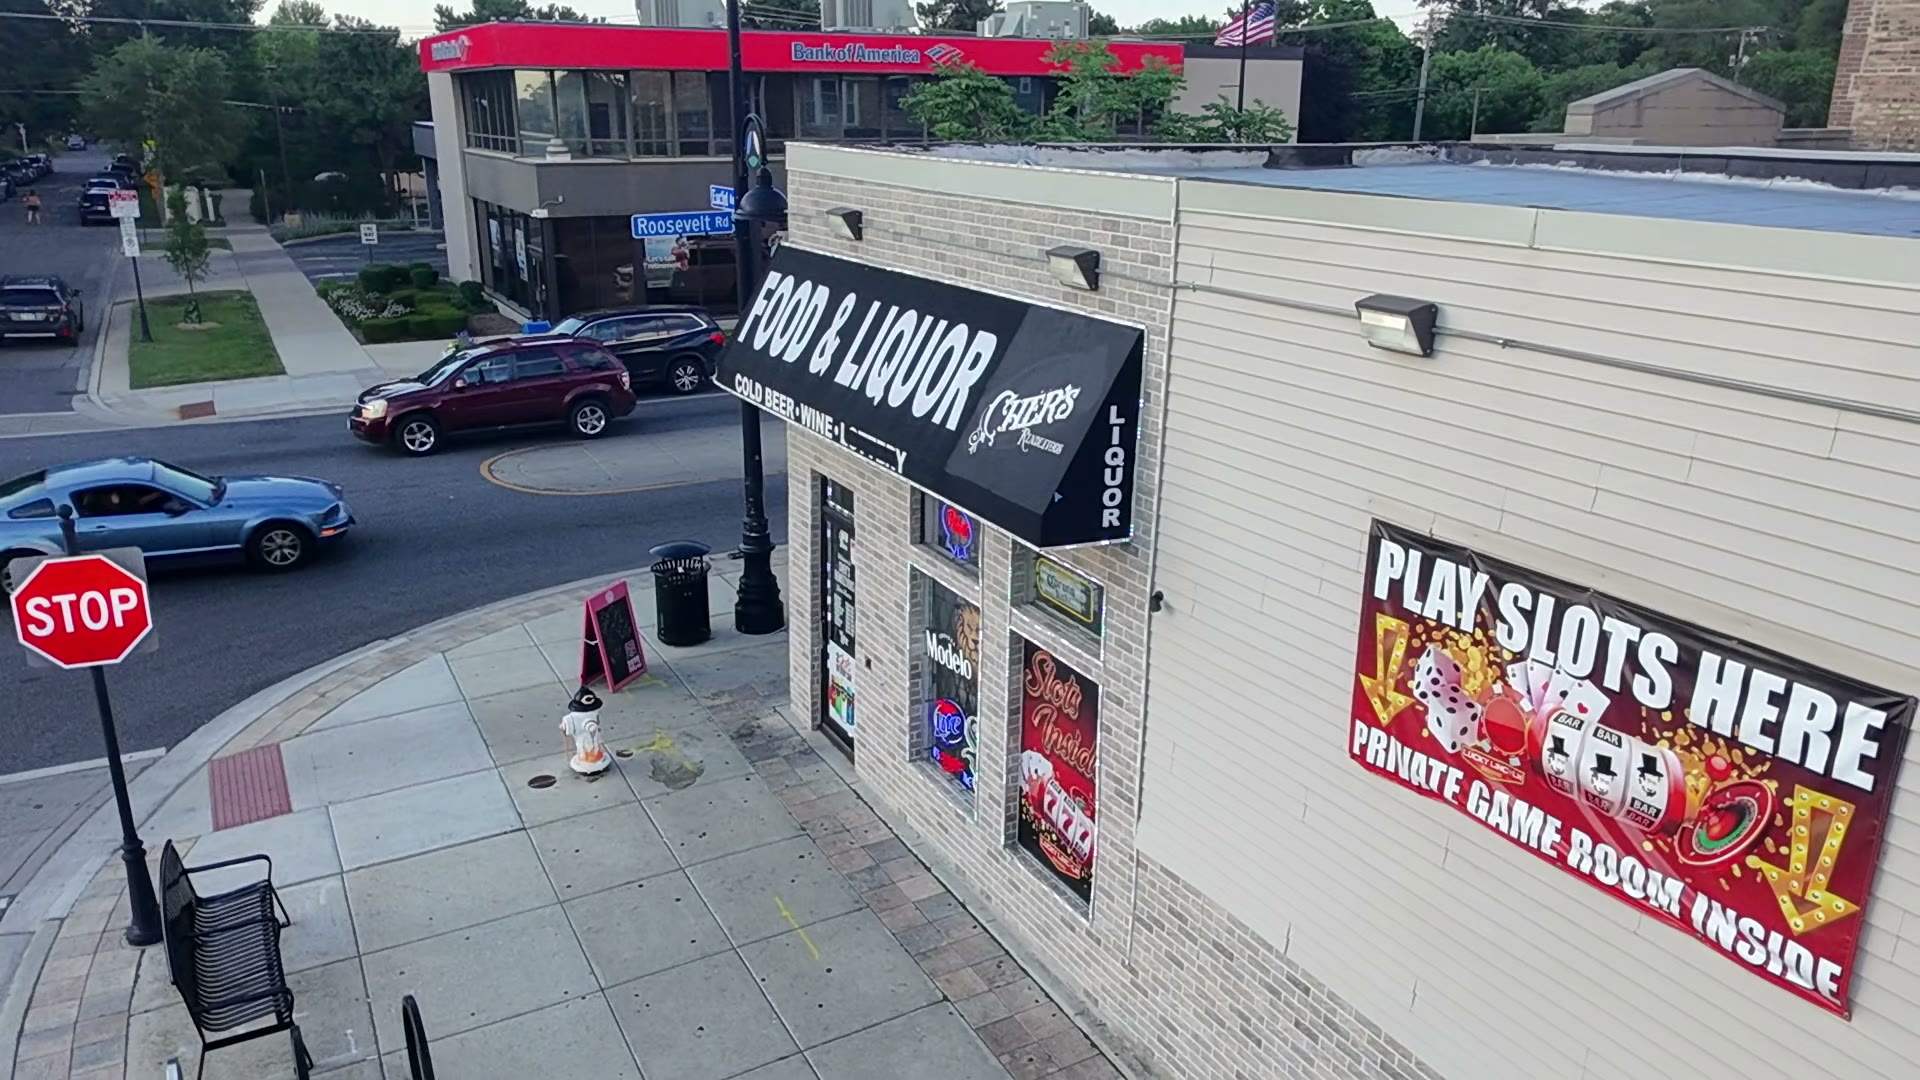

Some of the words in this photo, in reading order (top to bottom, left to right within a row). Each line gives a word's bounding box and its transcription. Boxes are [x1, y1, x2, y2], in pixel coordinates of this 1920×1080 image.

[791, 41, 836, 62] Bank
[835, 43, 854, 61] of
[854, 43, 921, 64] America
[637, 215, 711, 235] Roosevelt
[715, 216, 730, 229] Rd
[737, 270, 830, 363] FOOD
[808, 292, 857, 377] &
[833, 300, 998, 432] LIQUOR
[734, 372, 763, 404] COLD
[764, 386, 795, 421] BEER
[800, 402, 834, 440] WINE
[1101, 404, 1126, 528] LIQUOR
[25, 587, 139, 637] STOP
[925, 629, 973, 681] Modelo
[1373, 538, 1490, 634] PLAY
[1495, 582, 1679, 710] SLOTS
[1688, 650, 1889, 792] HERE
[1025, 650, 1083, 721] Slots
[1031, 703, 1096, 779] Insid
[1555, 712, 1583, 730] BAR
[1594, 726, 1621, 747] BAR
[1464, 749, 1491, 765] LUCKY
[1633, 802, 1658, 818] BAR
[1466, 779, 1562, 859] GAME
[1567, 827, 1687, 919] ROOM
[1690, 890, 1844, 1007] INSIDE
